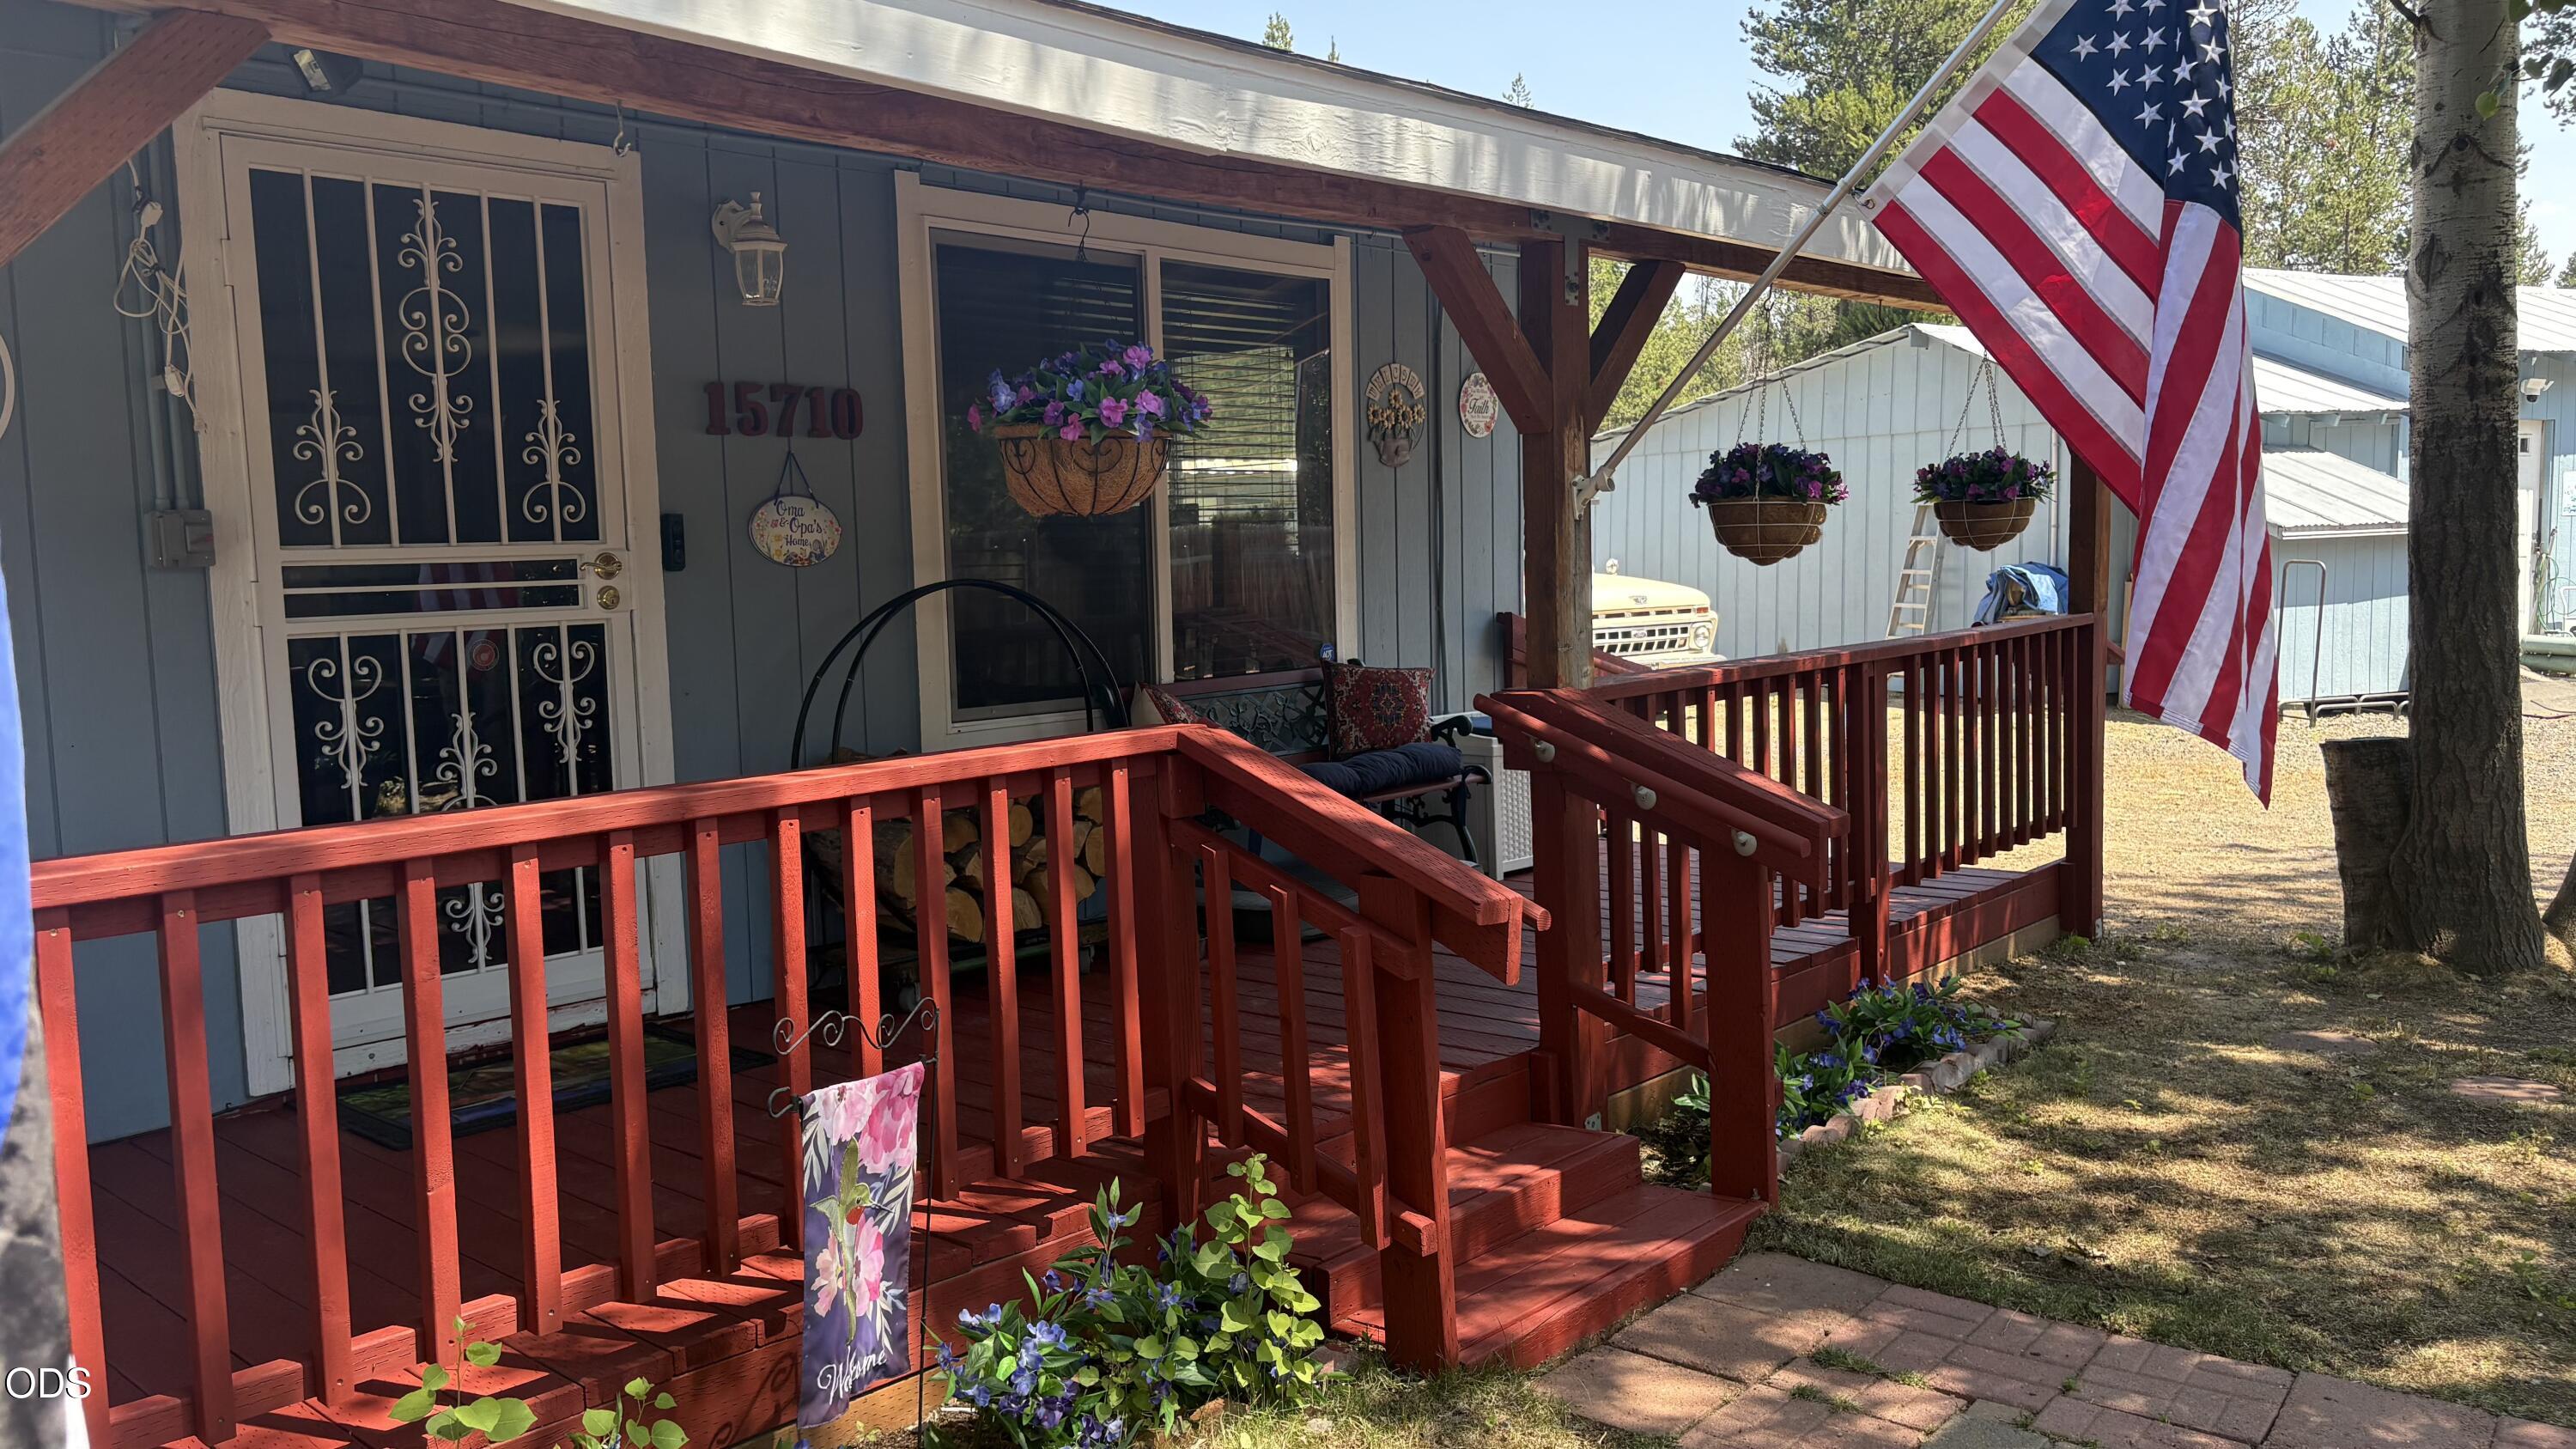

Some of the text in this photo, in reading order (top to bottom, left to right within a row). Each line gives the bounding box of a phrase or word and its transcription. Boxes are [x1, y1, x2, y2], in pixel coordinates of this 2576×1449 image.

[703, 381, 864, 440] 15710
[1467, 398, 1490, 414] Faith
[776, 500, 805, 517] Oma
[780, 517, 823, 538] & Opa's
[784, 534, 809, 547] Home
